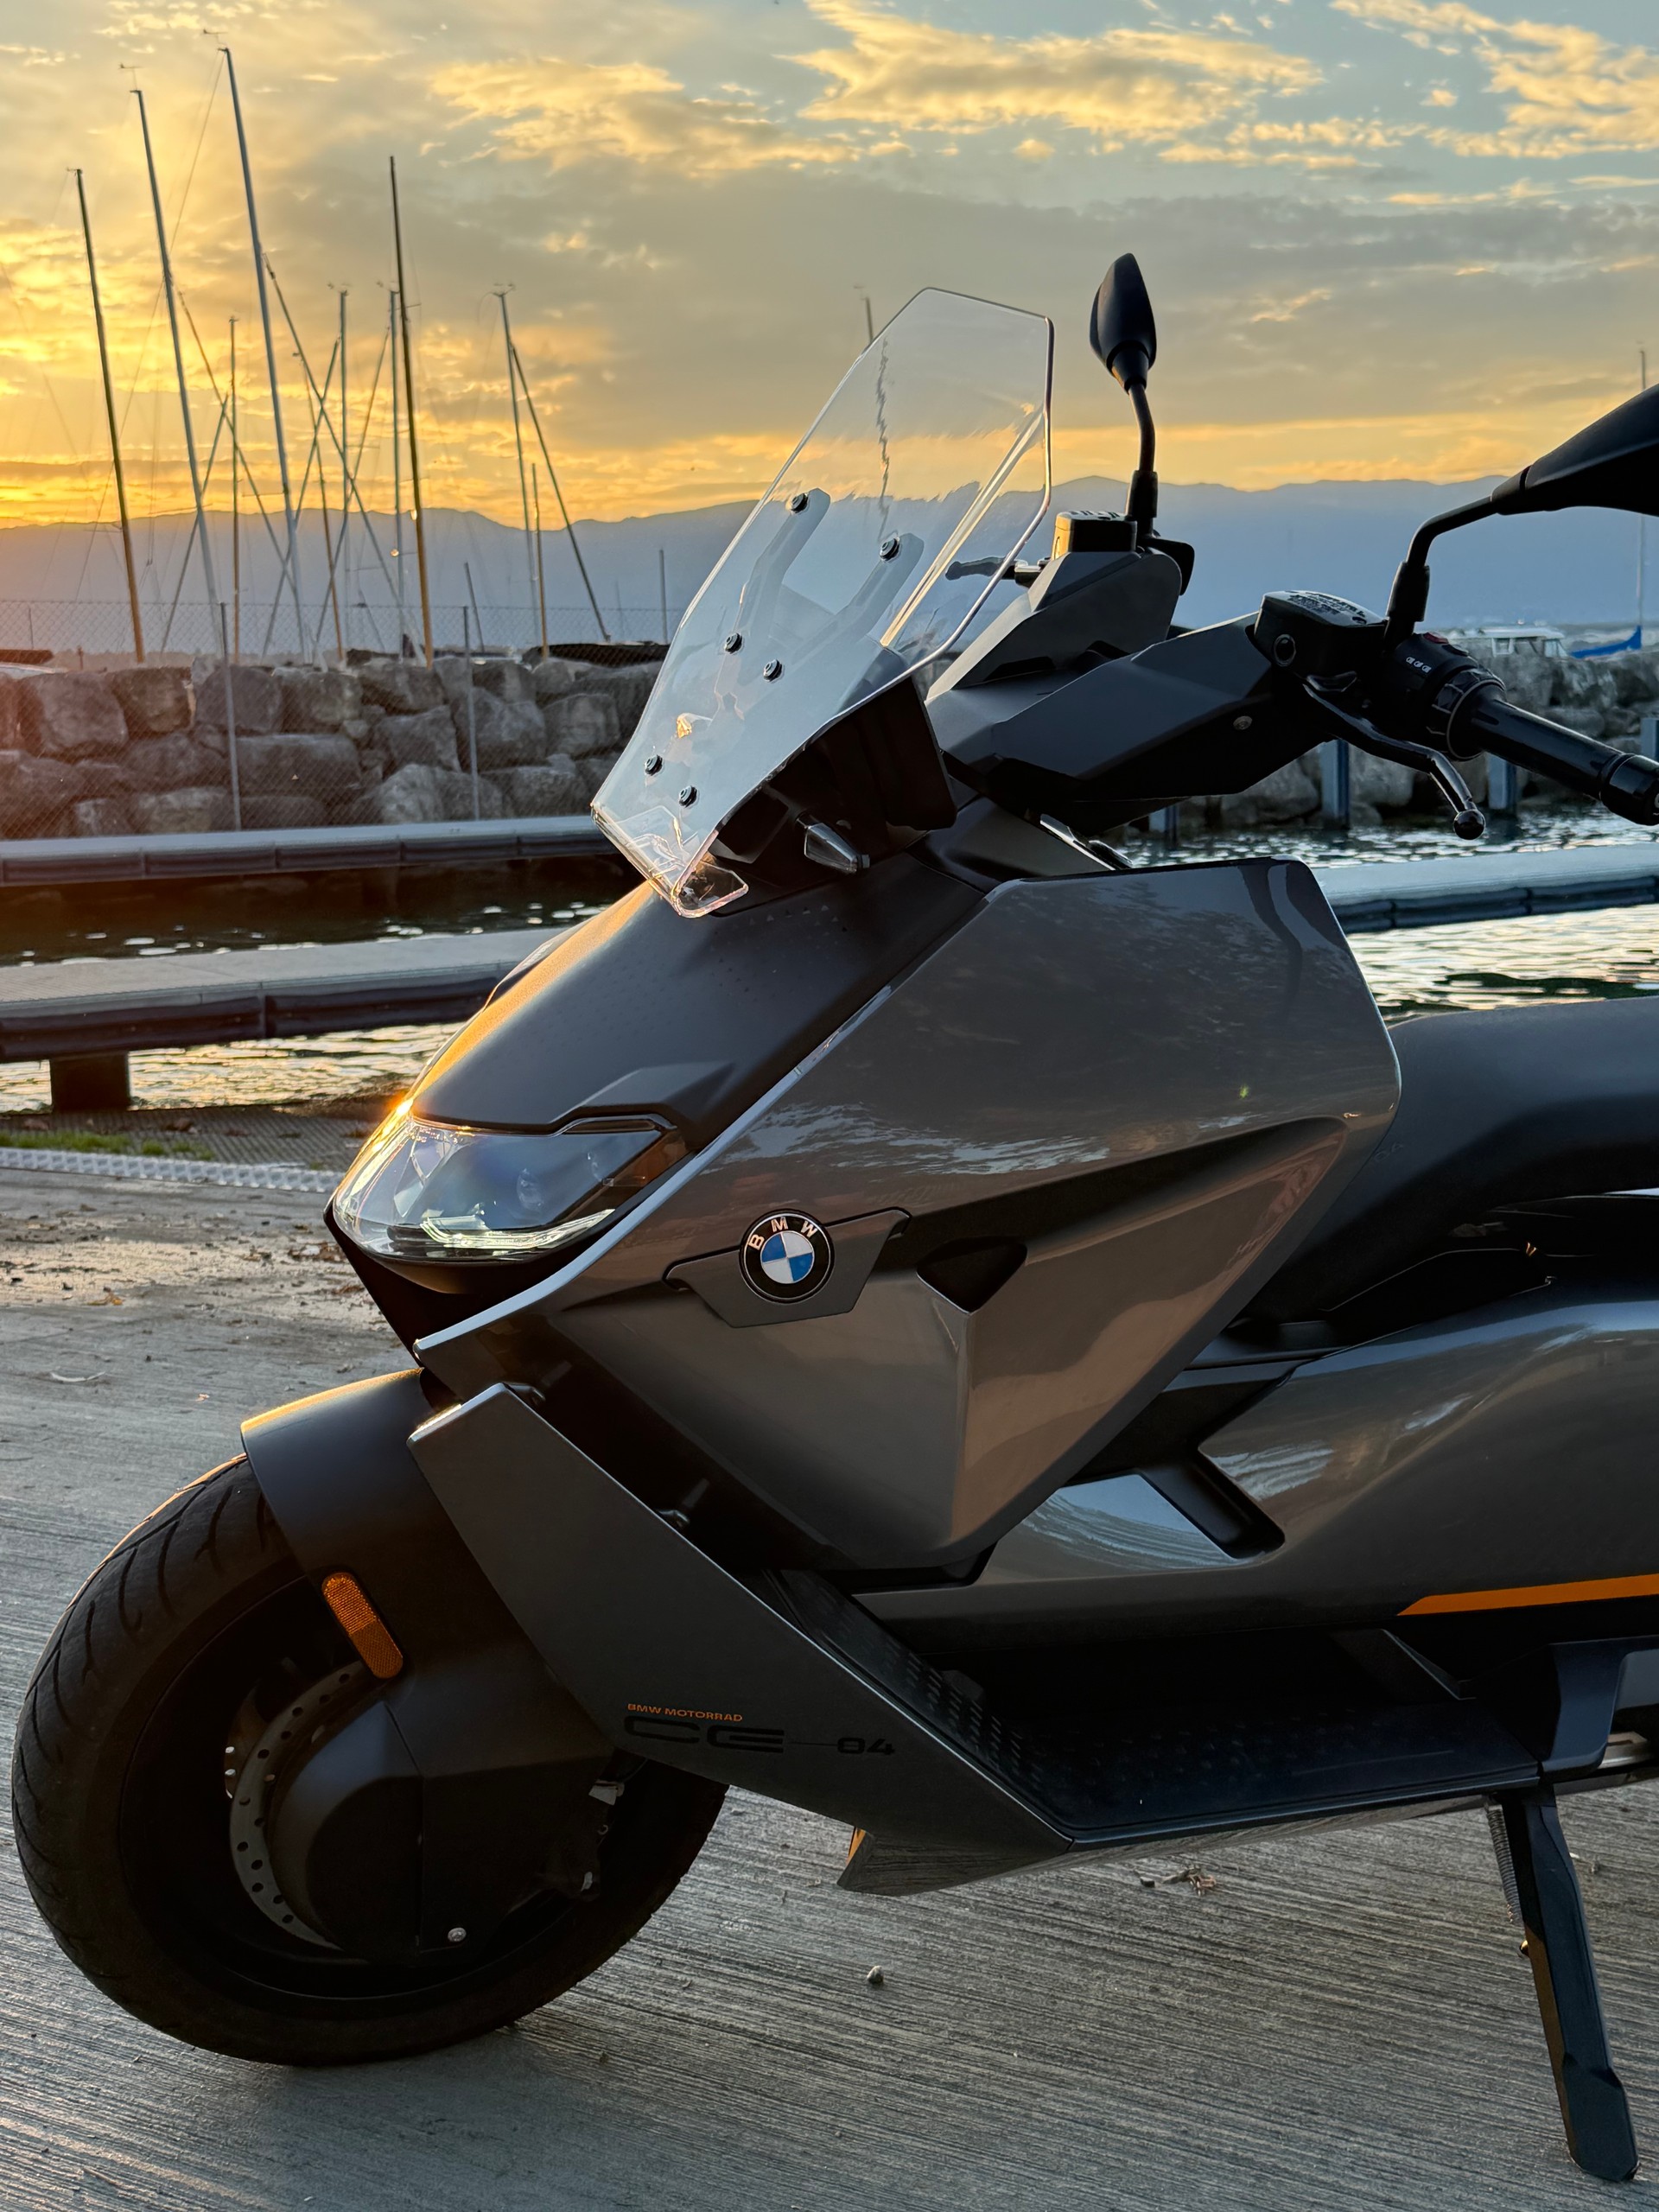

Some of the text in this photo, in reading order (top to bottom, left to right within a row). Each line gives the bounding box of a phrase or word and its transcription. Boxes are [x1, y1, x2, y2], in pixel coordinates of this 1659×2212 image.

[747, 1216, 818, 1251] BMW
[627, 1703, 743, 1722] BMW MOTORRAD
[623, 1715, 896, 1756] CE 04
